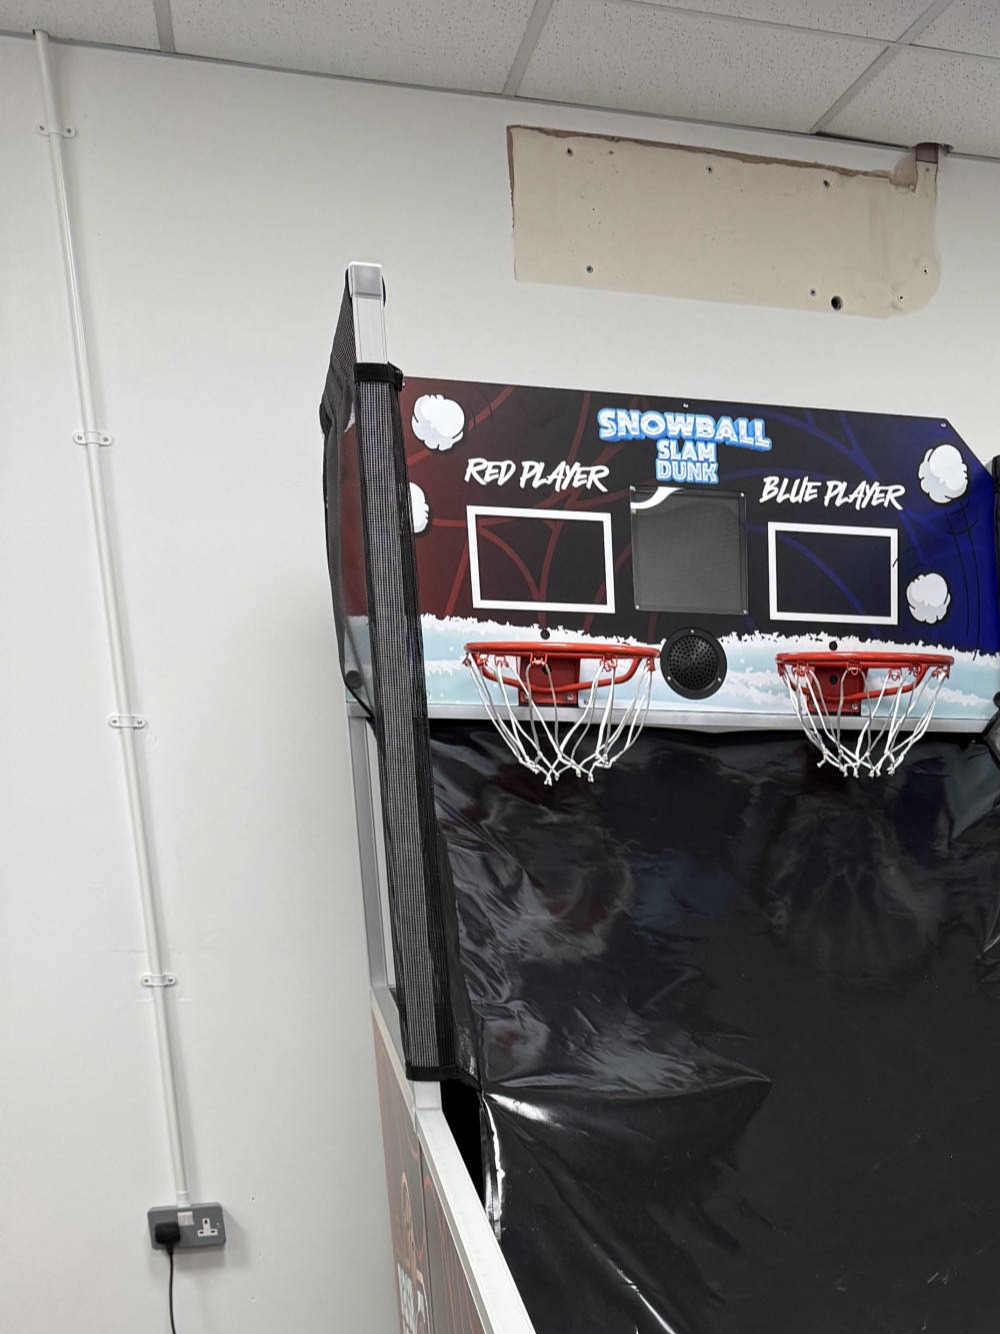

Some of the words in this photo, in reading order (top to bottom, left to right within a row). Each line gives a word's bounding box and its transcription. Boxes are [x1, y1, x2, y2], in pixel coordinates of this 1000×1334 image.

[597, 407, 773, 451] SNOWBALL
[656, 440, 718, 464] SLAM
[465, 457, 515, 487] RED
[520, 461, 610, 492] PLAYER
[656, 458, 719, 484] DUNK
[759, 476, 820, 504] BLUE
[822, 480, 906, 511] PLAYER
